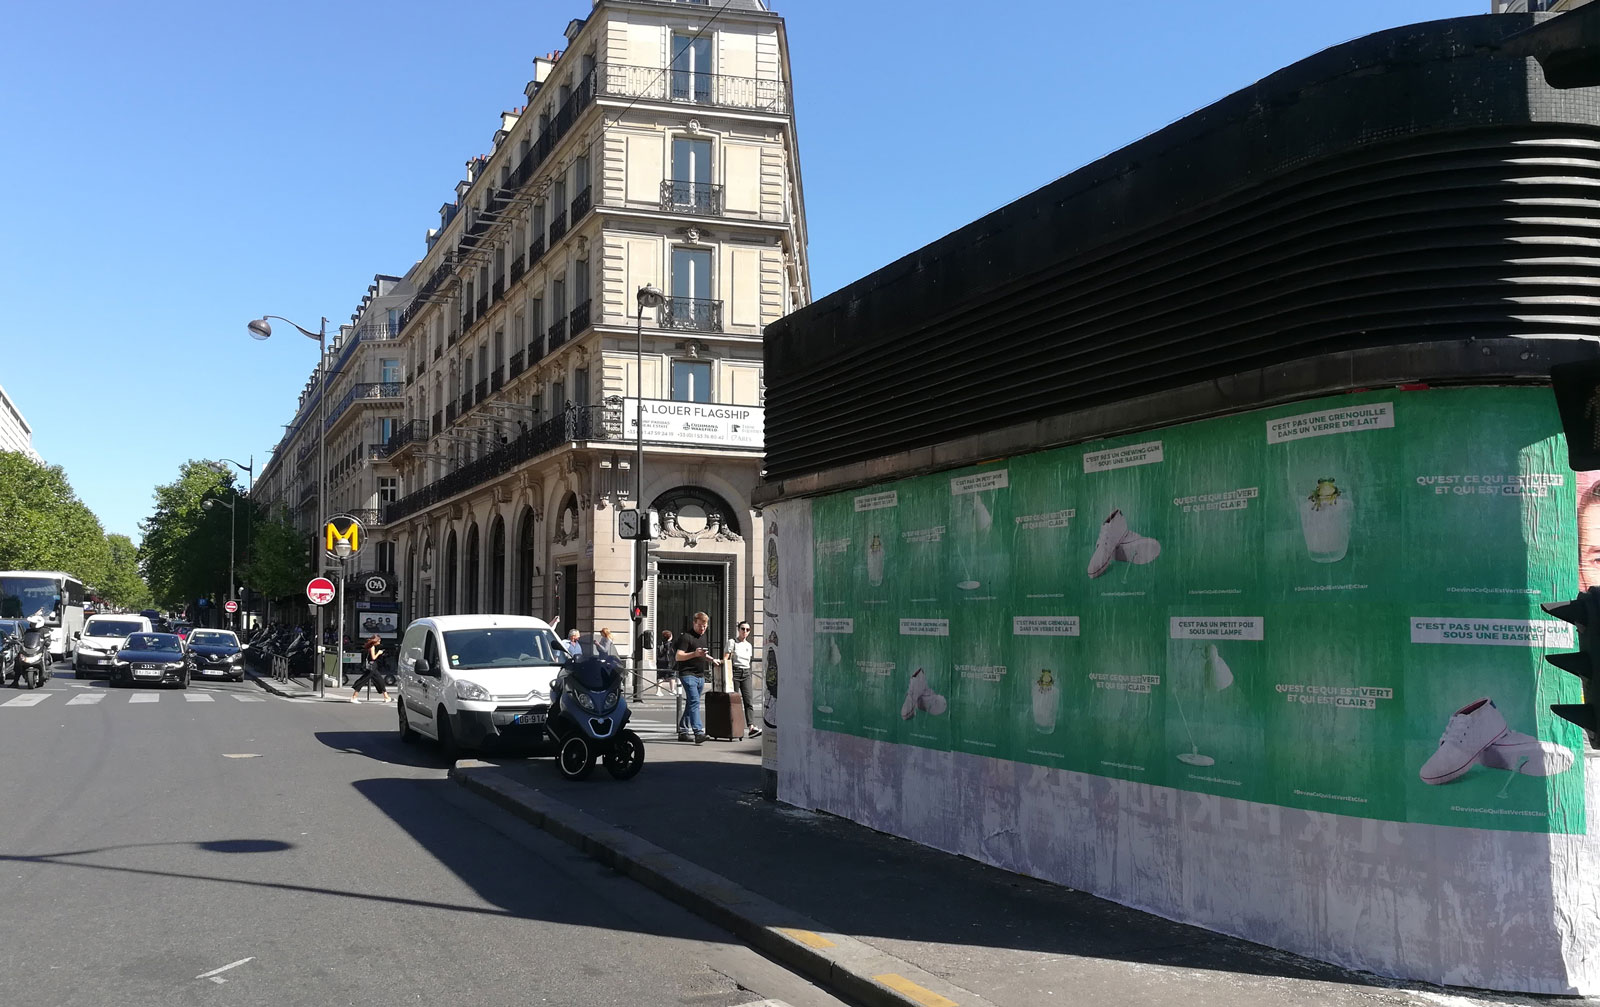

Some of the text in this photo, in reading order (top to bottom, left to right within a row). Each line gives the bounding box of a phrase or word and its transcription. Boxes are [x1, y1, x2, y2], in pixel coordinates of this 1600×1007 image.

[652, 404, 691, 416] LOUER
[694, 408, 750, 420] FLAGSHIP
[1272, 408, 1386, 432] C'EST PAS UNE GRENOUILLE
[1278, 430, 1298, 438] DANS
[1312, 422, 1340, 431] VERRE
[1358, 417, 1379, 425] LAIT
[1416, 476, 1460, 486] QU'EST
[1482, 475, 1503, 484] QUI
[1237, 489, 1257, 497] VERT
[1436, 486, 1450, 494] ET
[1453, 486, 1474, 495] QUI
[1479, 486, 1499, 494] EST
[326, 523, 358, 551] M
[1502, 633, 1544, 641] BASKET
[1275, 684, 1391, 697] QU'EST CE QUI EST VERT
[1300, 695, 1315, 704] QUI
